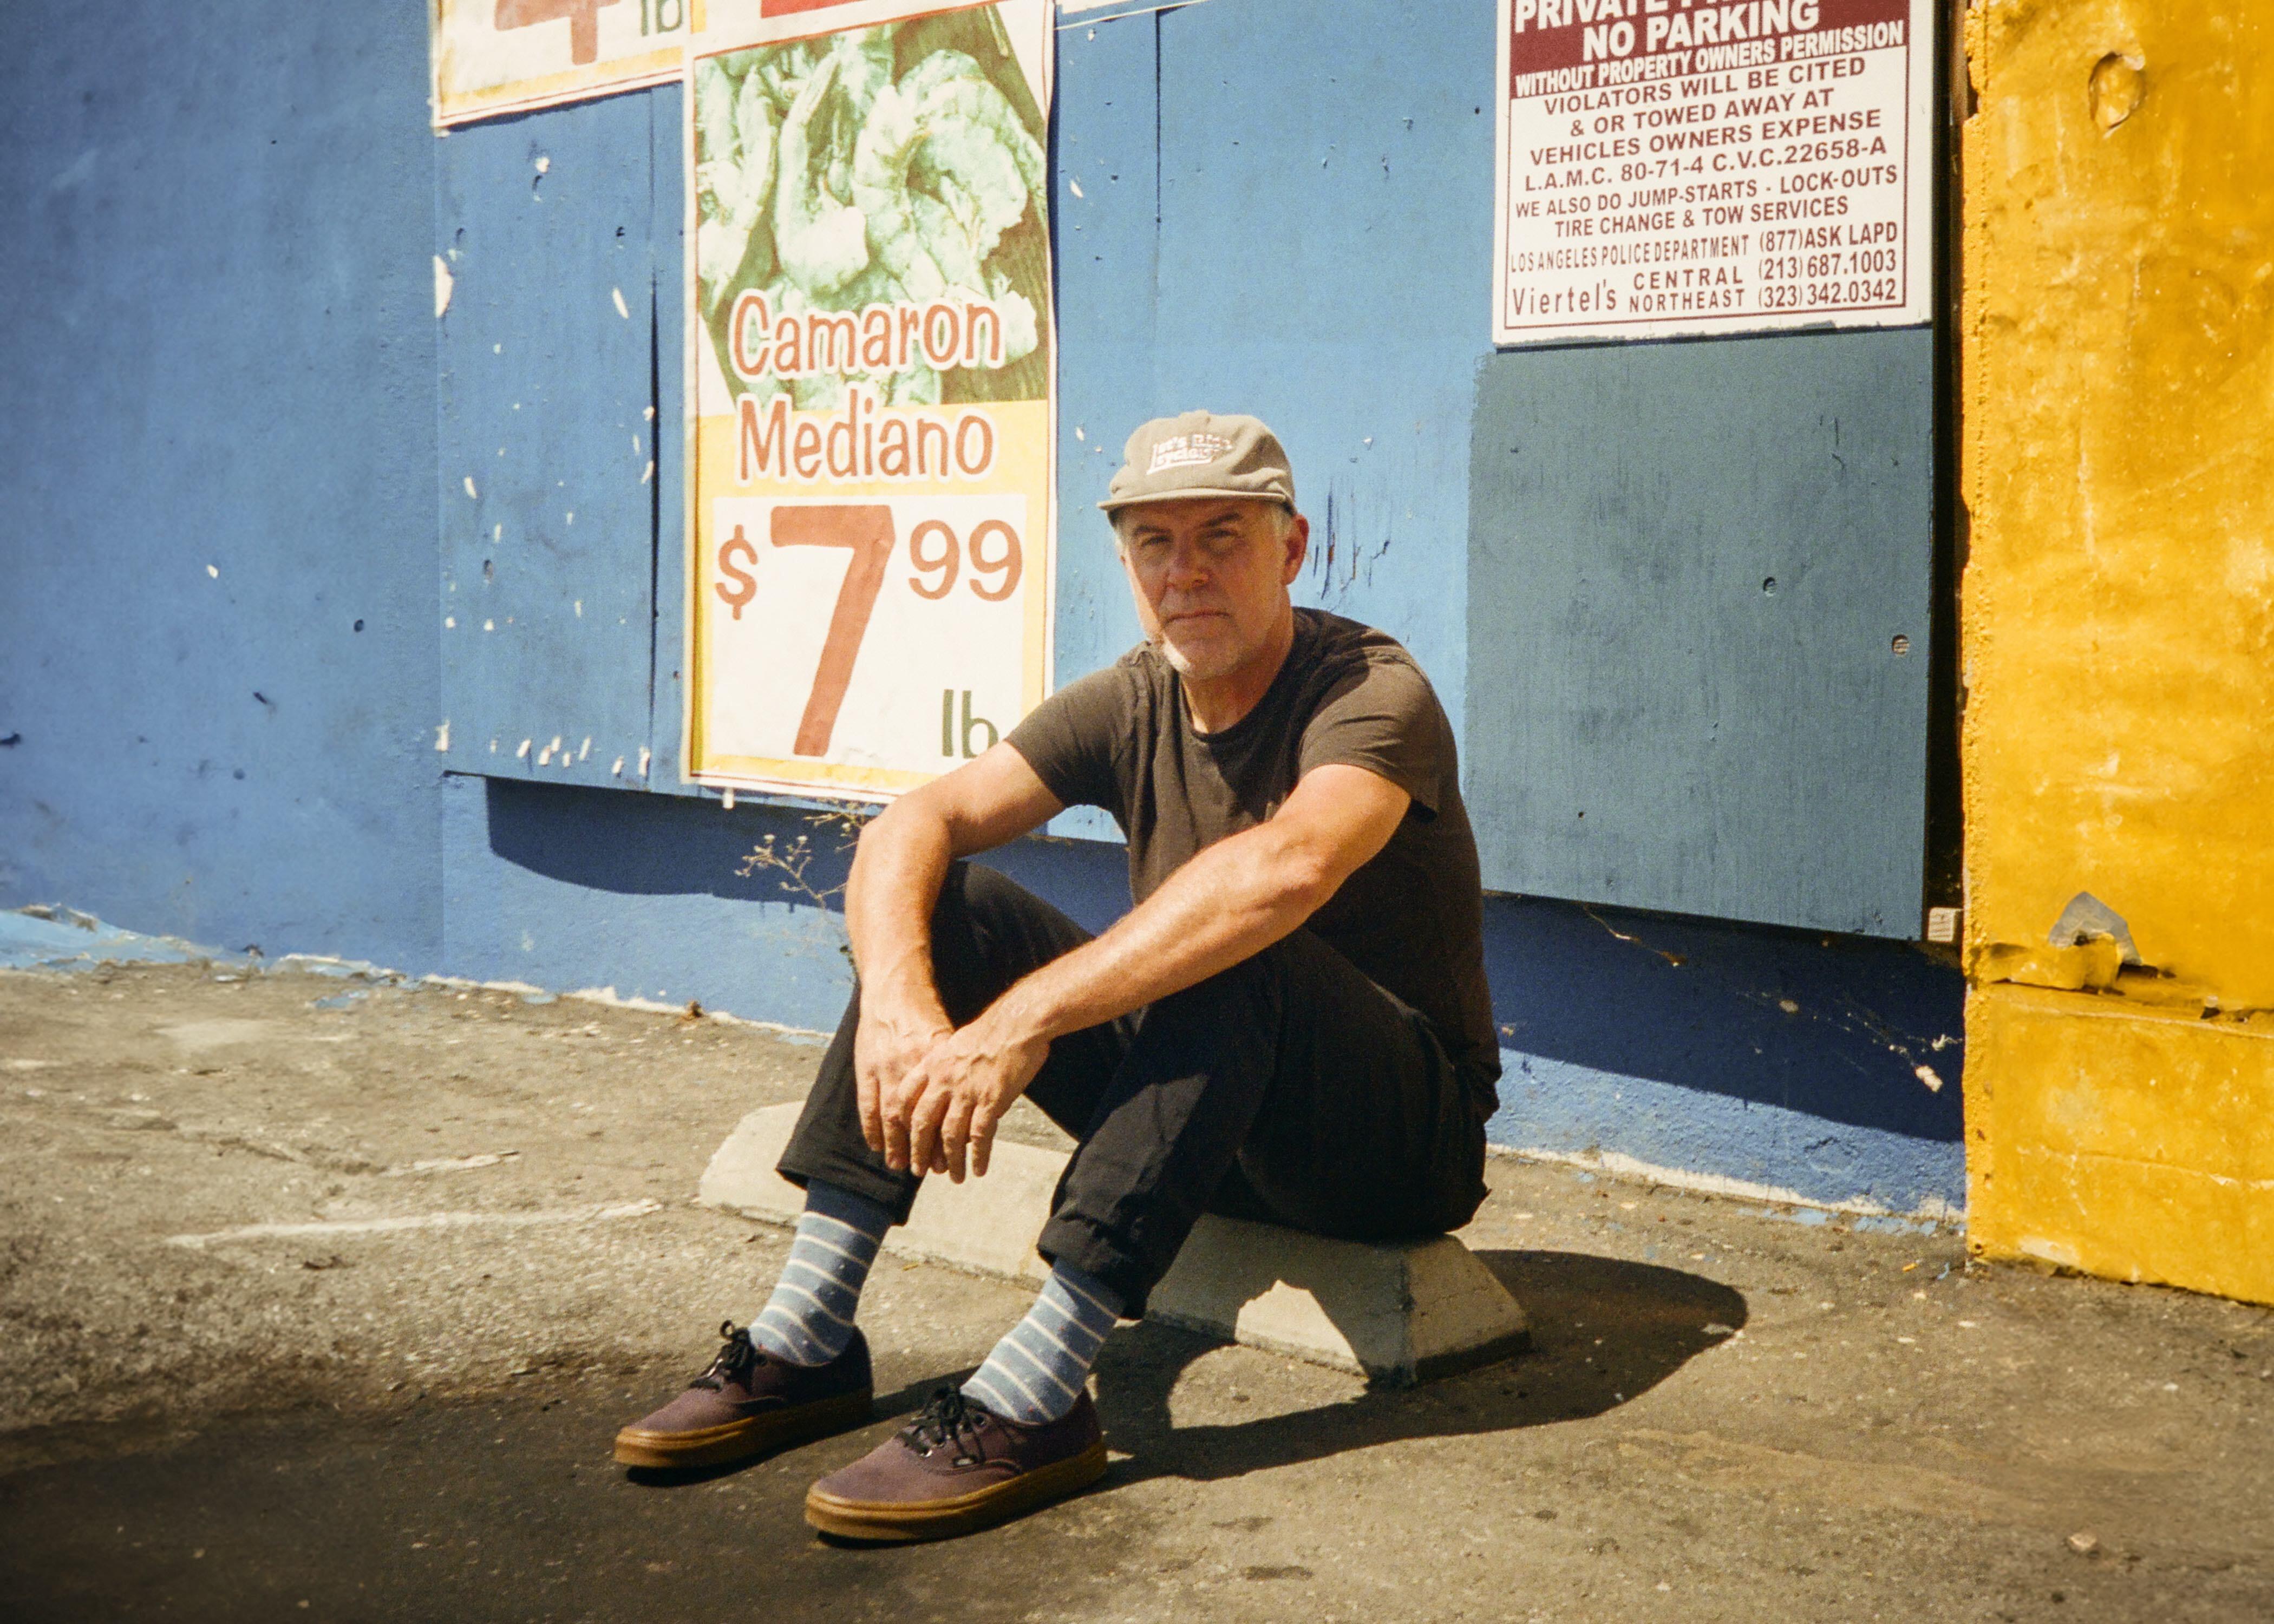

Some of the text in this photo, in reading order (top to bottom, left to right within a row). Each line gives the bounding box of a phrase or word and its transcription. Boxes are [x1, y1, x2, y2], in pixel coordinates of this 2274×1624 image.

[1583, 0, 1820, 61] NO PARKING
[1515, 19, 1904, 99] WITHOUT PROPERTY OWNERS PERMISSION
[1544, 56, 1865, 115] VIOLATORS WILL BE CITED
[1530, 109, 1880, 166] VEHICLES OWNERS EXPENSE
[1570, 87, 1834, 137] & OR TOWED AWAY AT
[1517, 201, 1539, 217] WE
[1547, 196, 1591, 214] ALSO
[1598, 193, 1621, 211] DO
[1628, 179, 1757, 208] JUMP-STARTS
[1780, 164, 1897, 194] LOCK-OUTS
[1525, 166, 1613, 192] L.A.M.C.
[1621, 156, 1703, 181] 80-71-4
[1555, 195, 1848, 237] TIRE CHANGE & TOW SERVICES
[1512, 252, 1534, 272] LOS
[1538, 247, 1597, 271] ANGELES
[1602, 243, 1650, 266] POLICE
[1655, 234, 1749, 262] DEPARTMENT
[1849, 221, 1898, 245] LAPD
[1513, 279, 1616, 315] Viertel's
[1630, 289, 1744, 312] NORTHEAST
[1633, 266, 1743, 291] CENTRAL
[733, 295, 1000, 376] Camaron
[739, 390, 994, 481] Mediano
[942, 689, 1000, 759] lb
